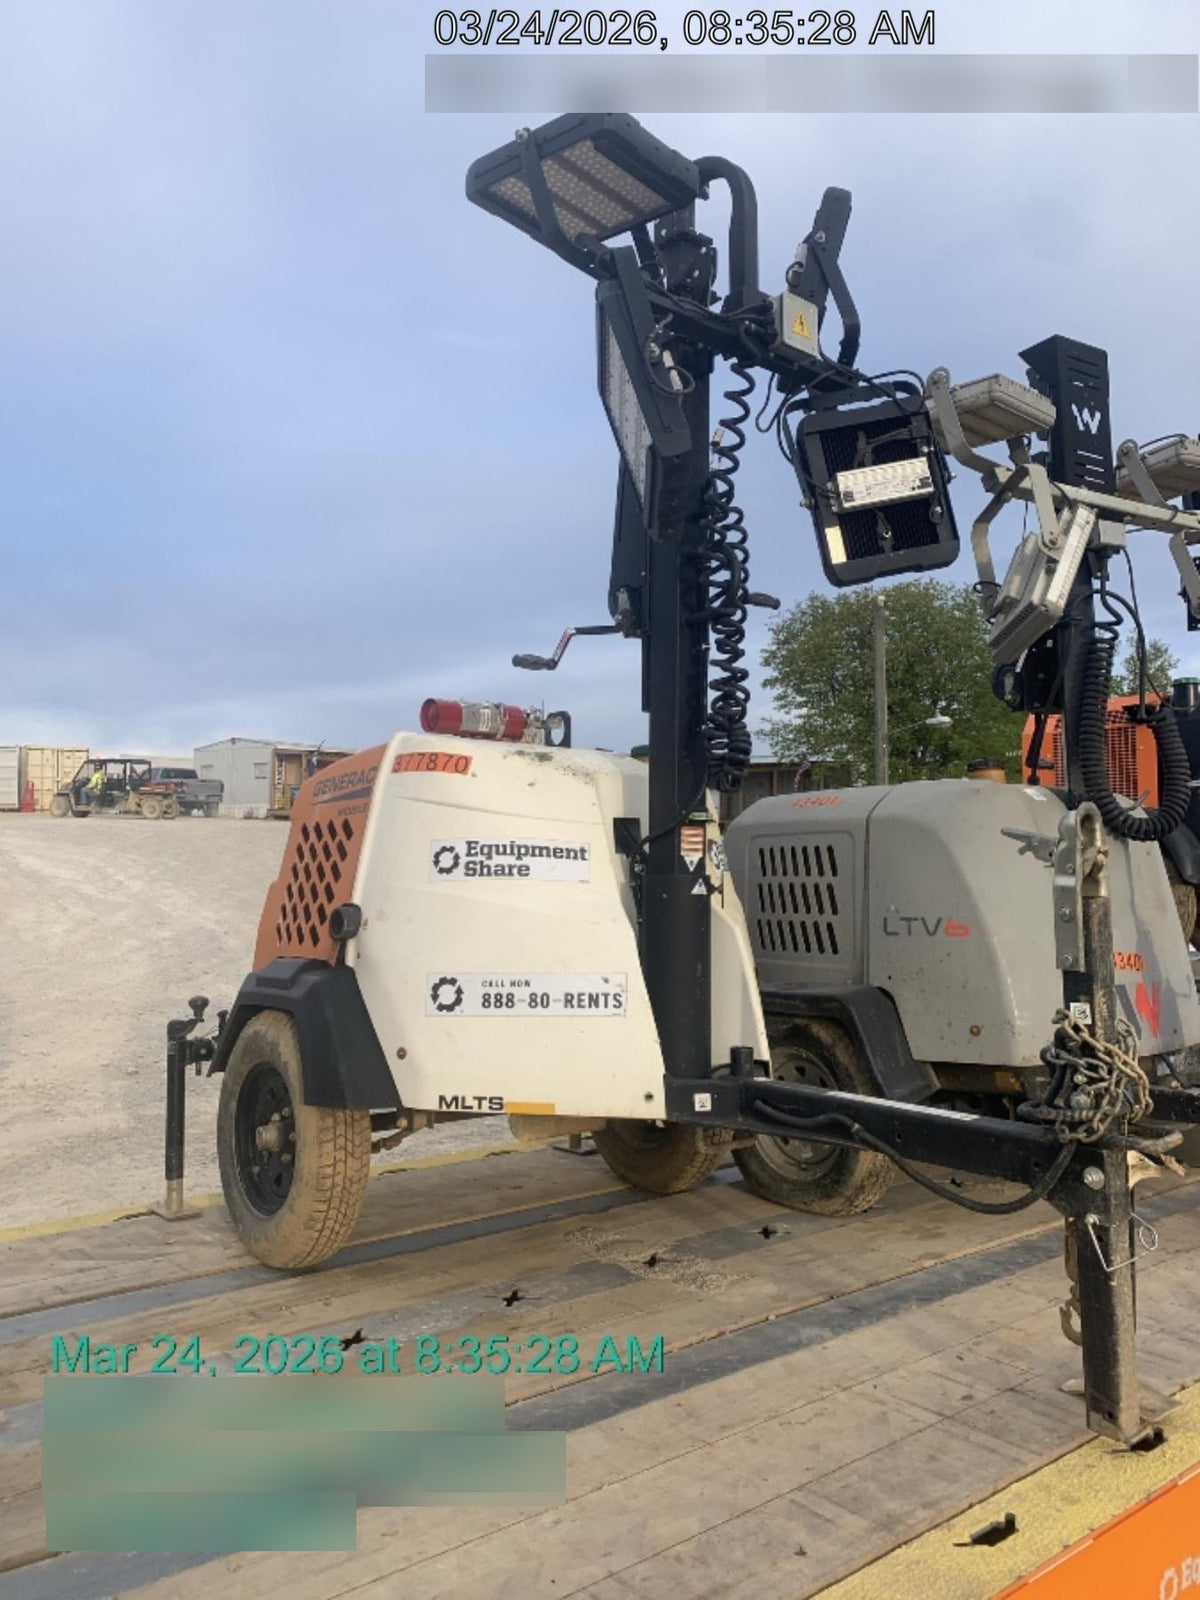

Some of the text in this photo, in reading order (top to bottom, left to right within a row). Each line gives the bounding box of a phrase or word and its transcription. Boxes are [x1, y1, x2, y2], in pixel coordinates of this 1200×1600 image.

[313, 766, 379, 797] GENERAC
[465, 840, 588, 861] Equipment
[464, 860, 530, 877] Share
[481, 979, 532, 989] CALL NOW
[481, 991, 623, 1010] 888-80-RENTS
[438, 1094, 504, 1111] MLTS
